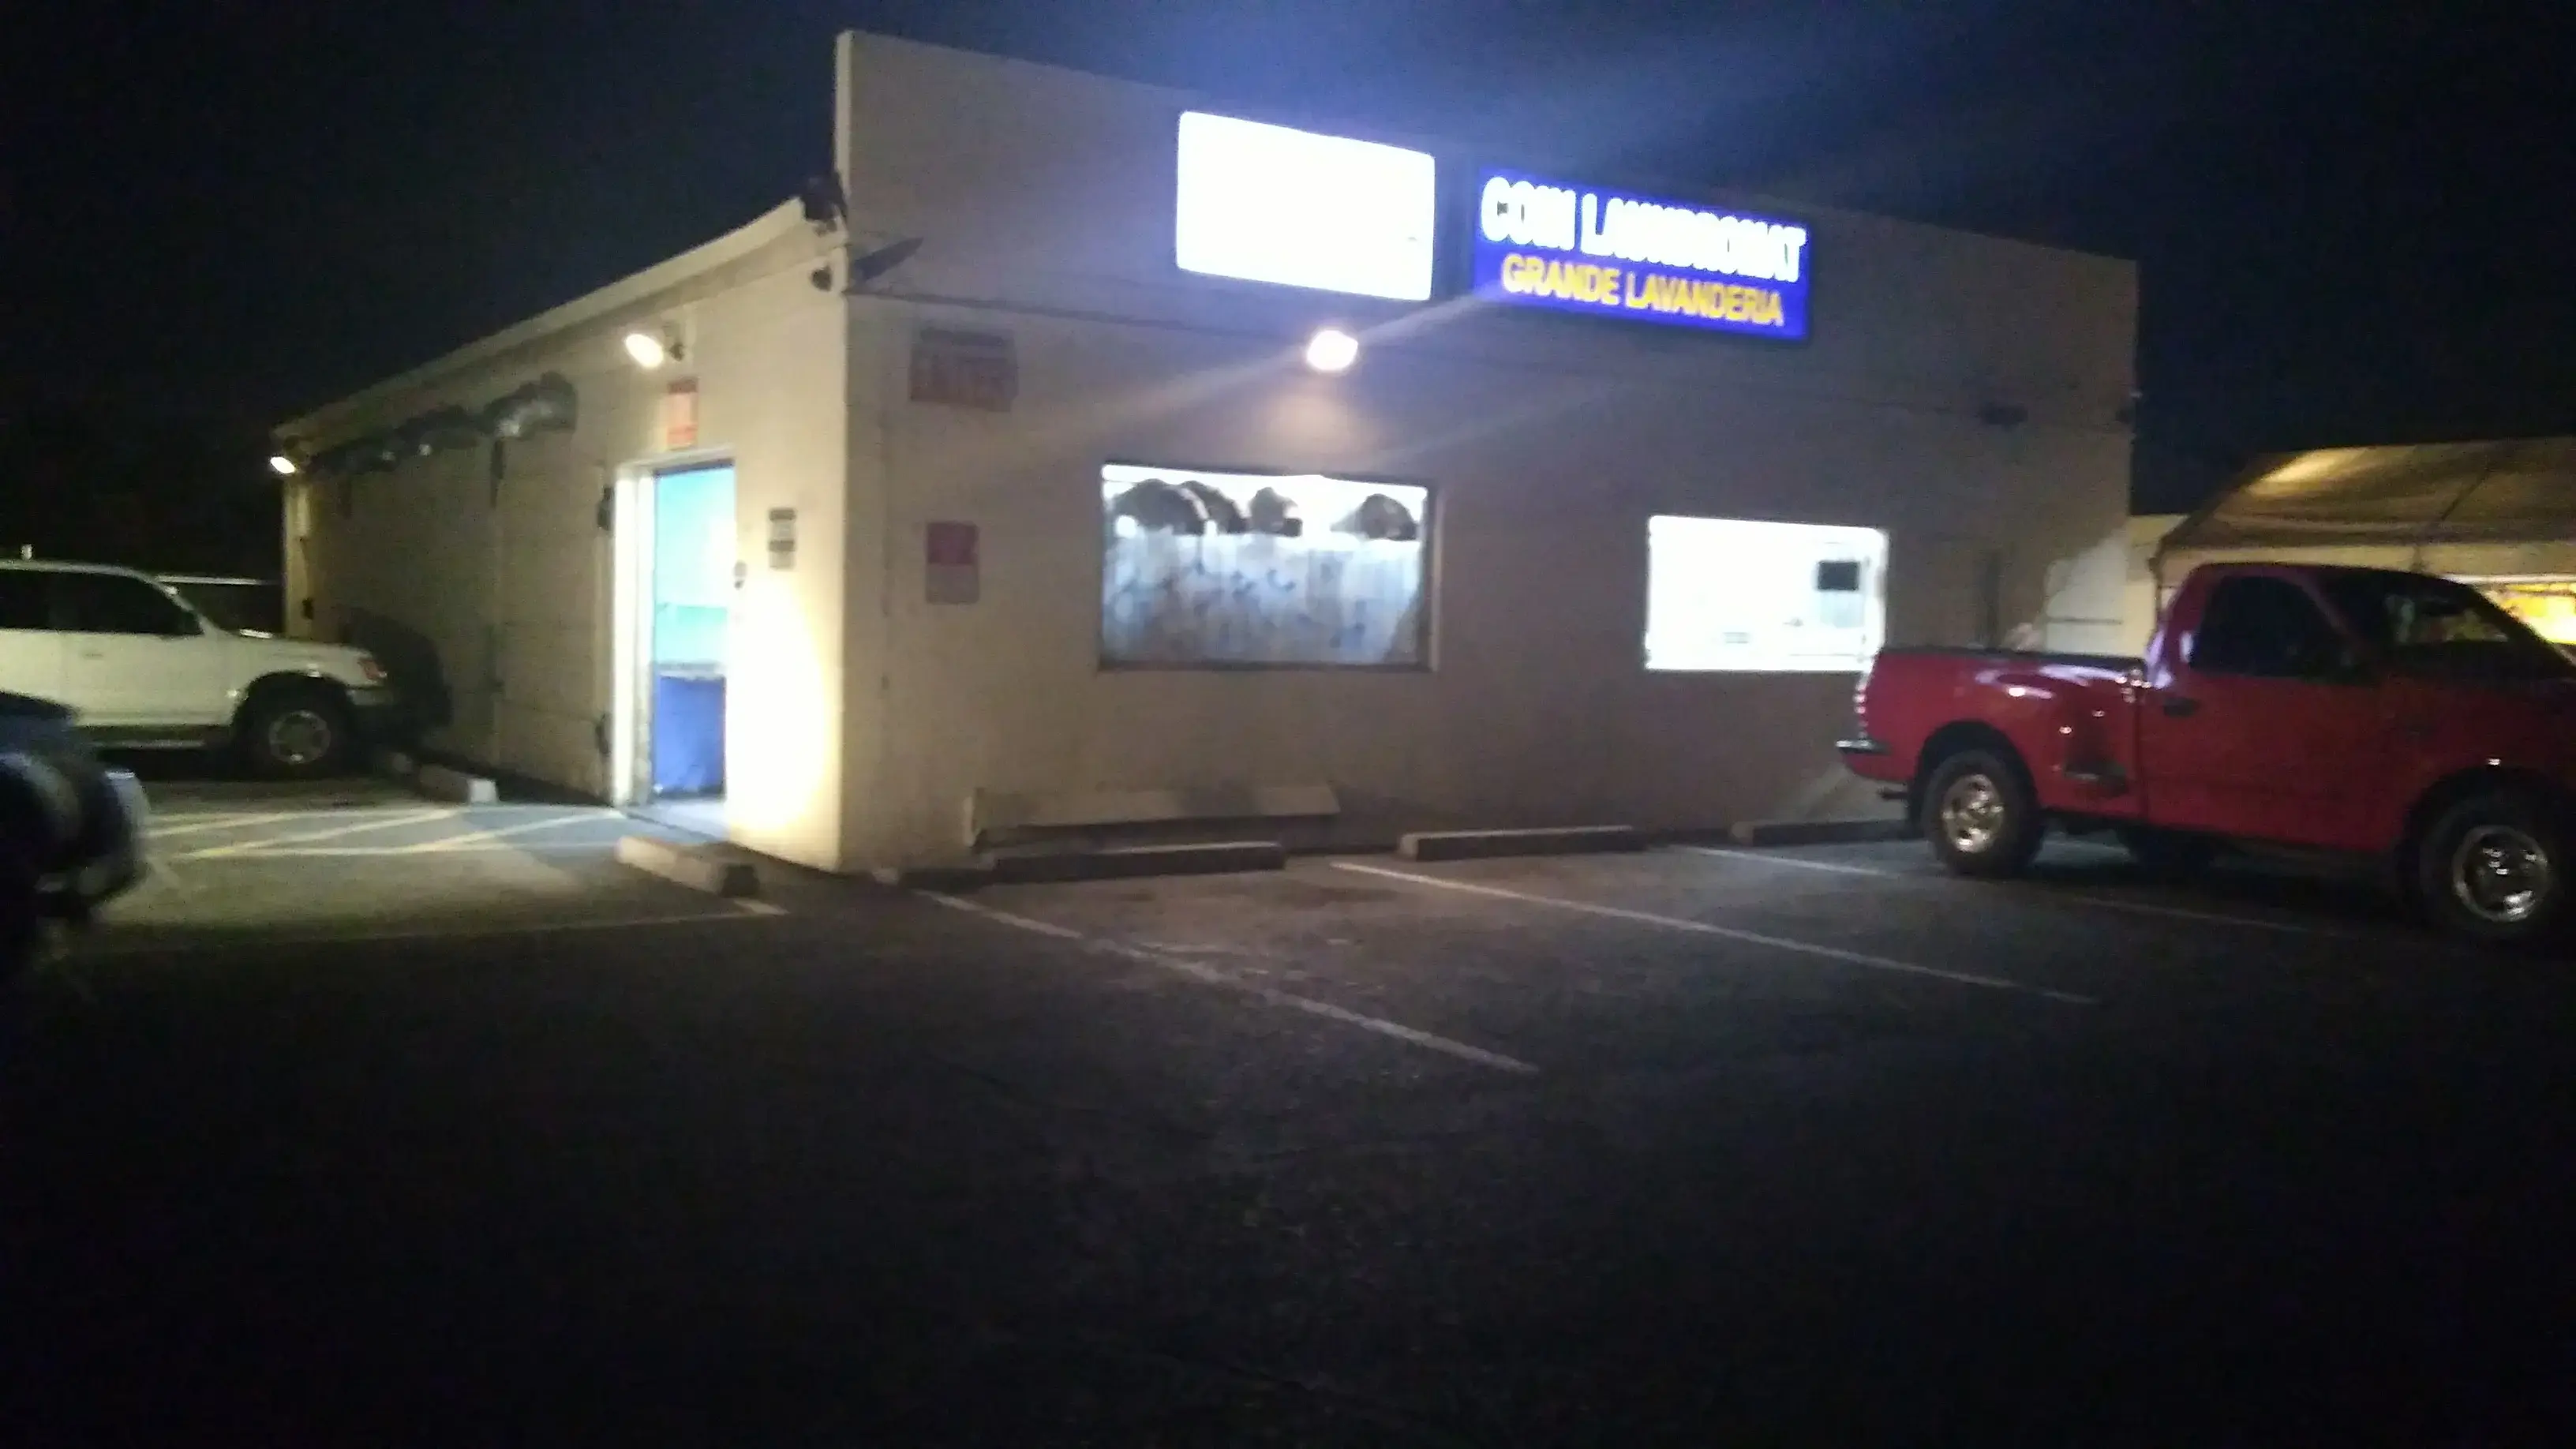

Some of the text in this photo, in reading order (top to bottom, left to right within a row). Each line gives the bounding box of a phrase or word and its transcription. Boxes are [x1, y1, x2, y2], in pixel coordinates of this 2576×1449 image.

[1481, 176, 1807, 283] COIN LAUNDROMAT
[1502, 253, 1784, 327] GRANDE LAVANDERIA
